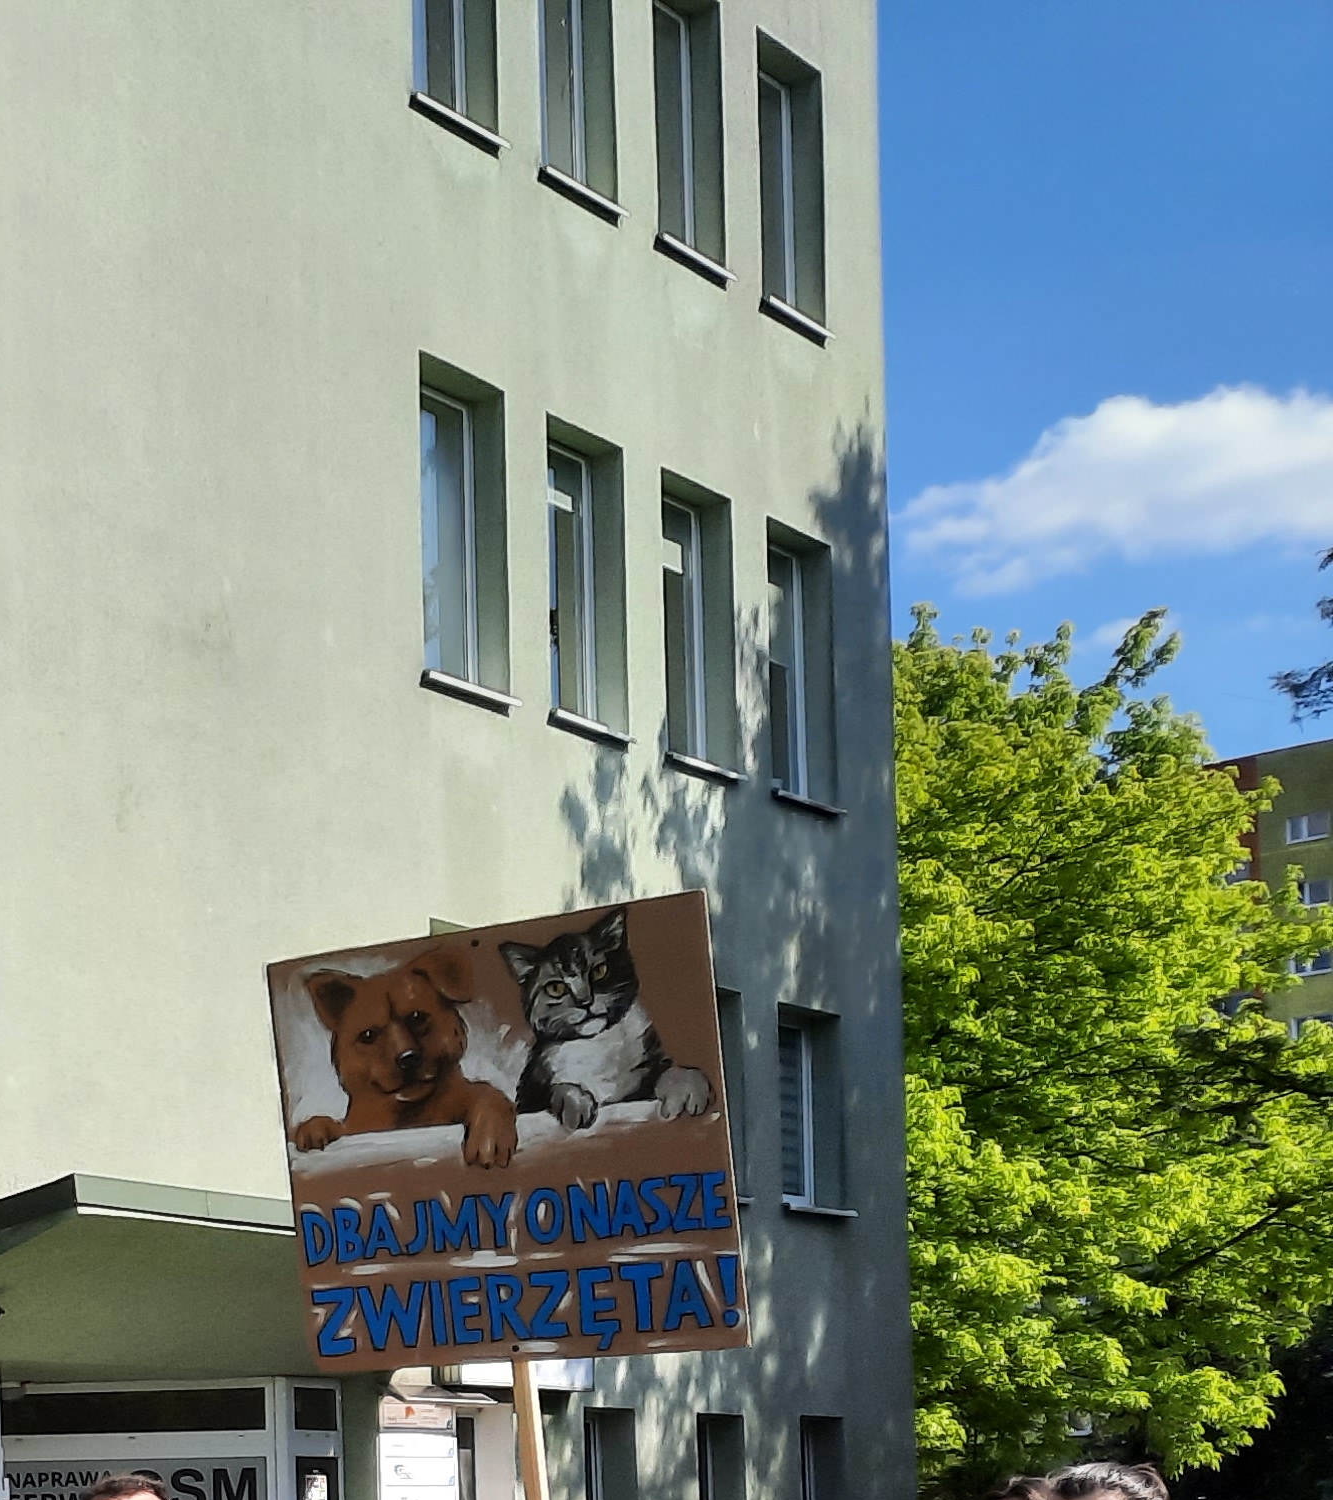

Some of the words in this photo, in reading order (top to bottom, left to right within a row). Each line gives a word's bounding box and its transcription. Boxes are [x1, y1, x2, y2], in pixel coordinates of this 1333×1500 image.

[300, 1192, 514, 1267] DBAJMY
[311, 1254, 742, 1358] ZWIERZĘTA!
[6, 1469, 112, 1489] NAPRAW
